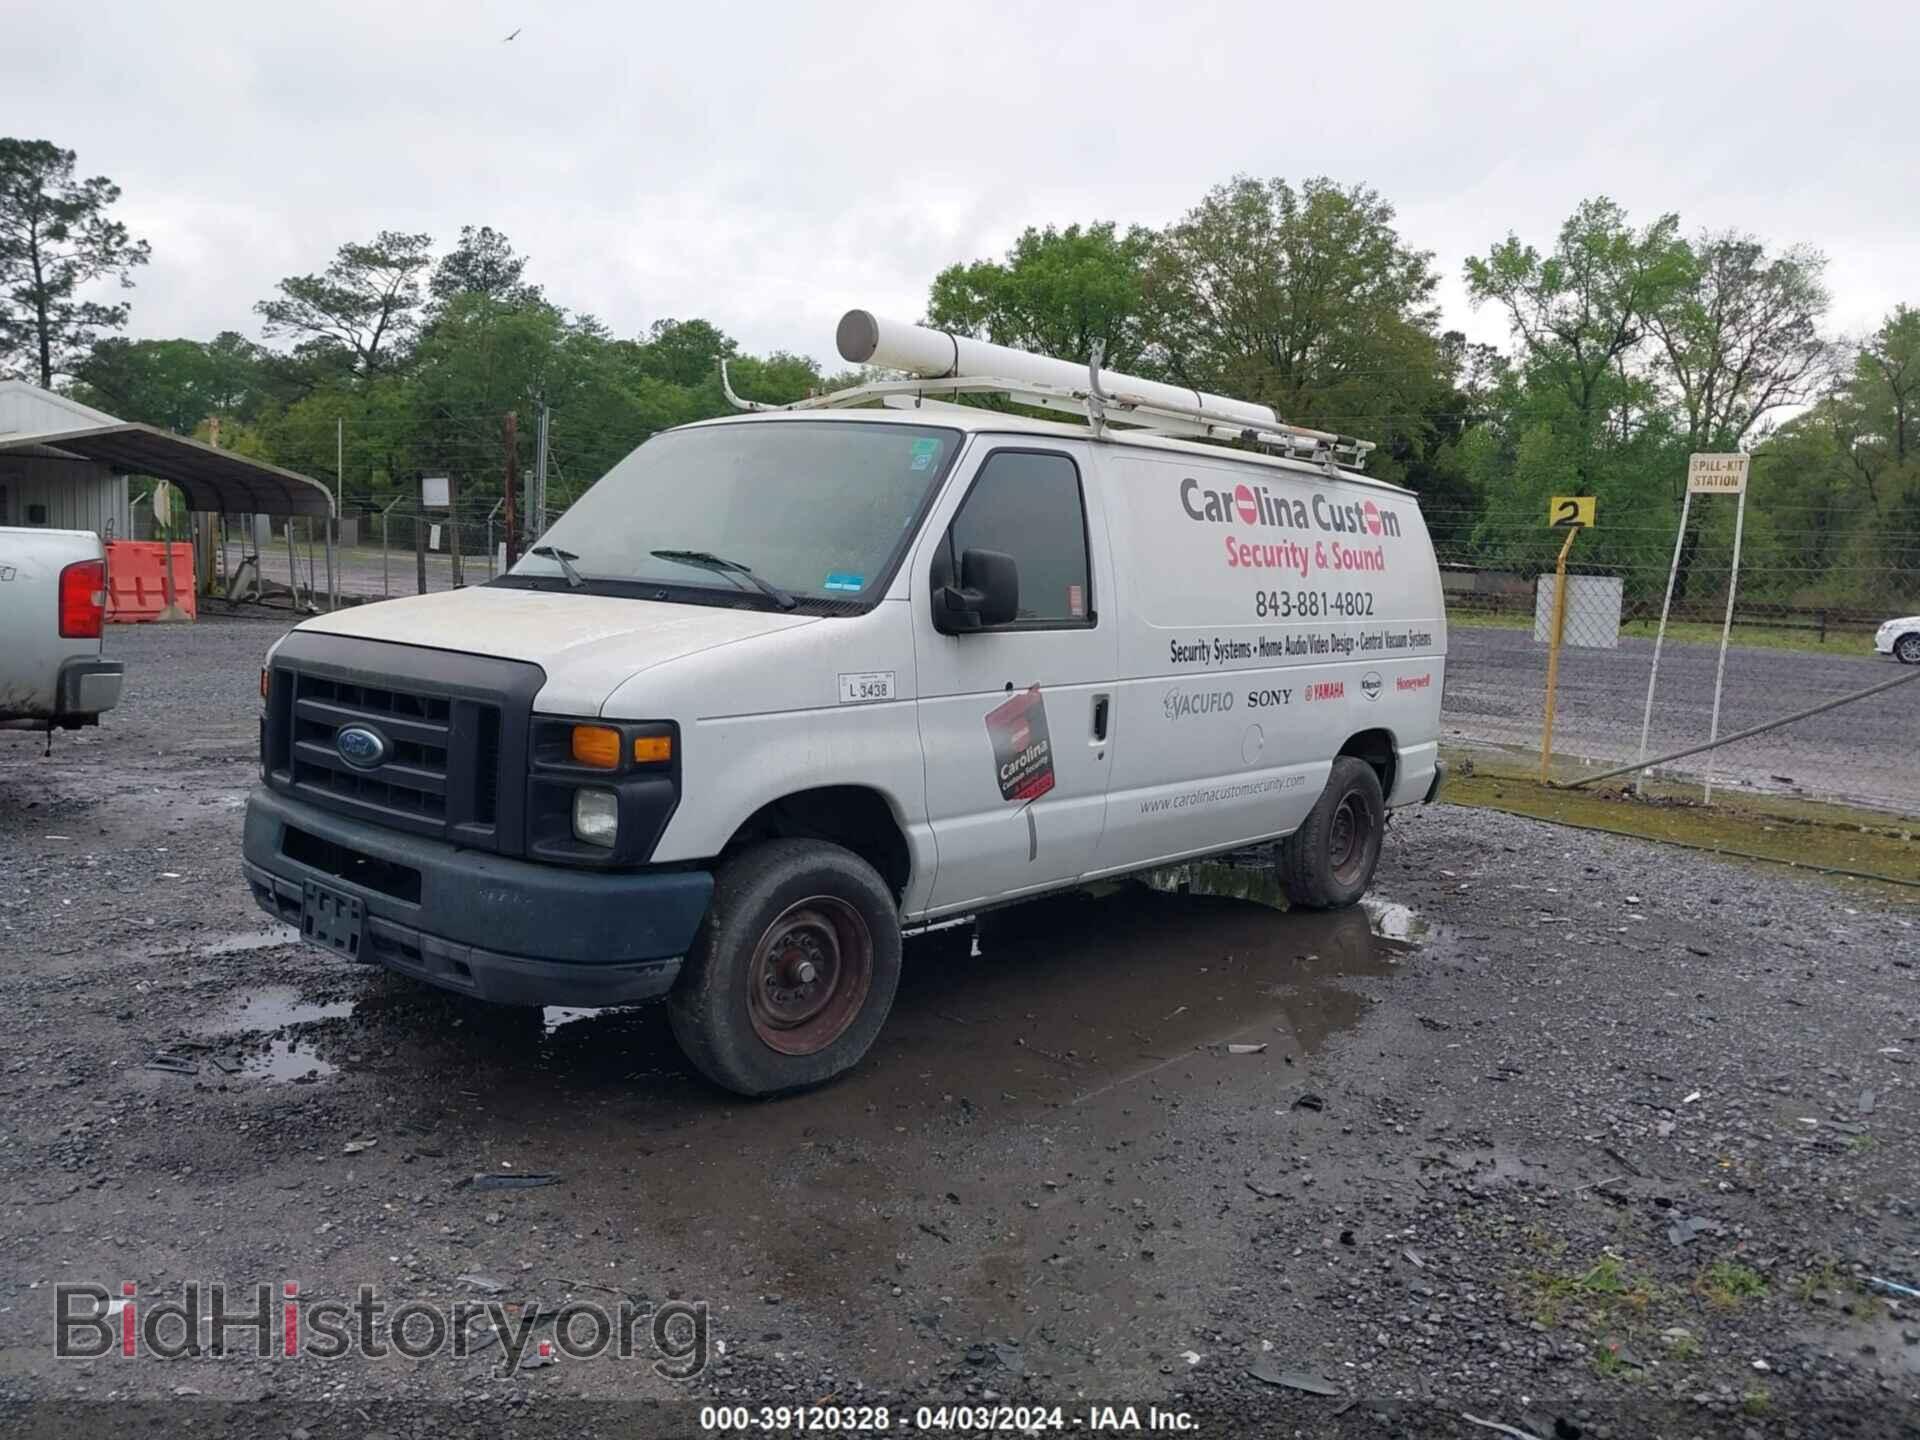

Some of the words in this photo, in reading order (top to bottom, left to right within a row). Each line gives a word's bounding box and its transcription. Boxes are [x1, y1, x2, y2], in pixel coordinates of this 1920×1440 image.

[1692, 459, 1745, 472] SPILL-KIT
[1694, 475, 1740, 487] STATION
[1180, 478, 1310, 530] Carolina
[1312, 494, 1401, 538] Custom
[1552, 501, 1586, 527] 2
[1225, 536, 1309, 578] Security
[1315, 541, 1329, 568] &
[1332, 541, 1385, 571] Sound
[1255, 590, 1374, 617] 843-881-4802
[1170, 639, 1211, 665] Security
[1214, 638, 1251, 664] Systems
[1259, 636, 1283, 657] Home
[1285, 635, 1308, 656] Audio
[1308, 634, 1329, 654] Video
[1331, 633, 1354, 656] Design
[1360, 631, 1384, 650] Central
[1385, 631, 1407, 649] Vacuum
[1409, 629, 1432, 650] Systems
[860, 683, 888, 698] 3438
[1247, 688, 1293, 708] SONY
[1314, 681, 1345, 701] YAMAHA
[1173, 691, 1234, 719] VACUFLO
[1000, 740, 1048, 780] Carolina
[1139, 775, 1305, 814] www.carolinacustomsecurity.com
